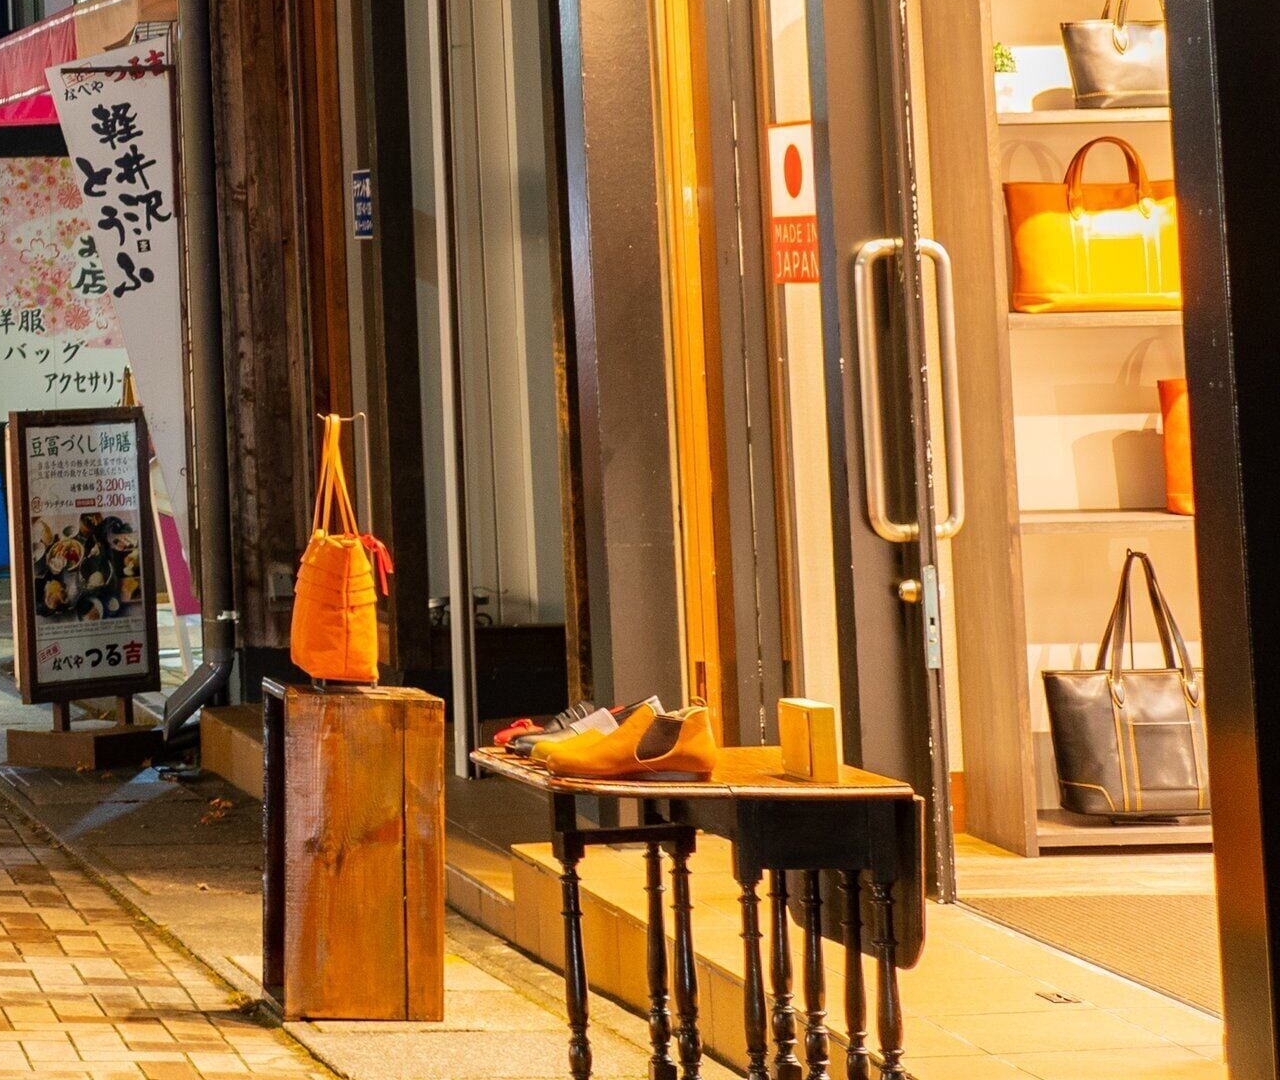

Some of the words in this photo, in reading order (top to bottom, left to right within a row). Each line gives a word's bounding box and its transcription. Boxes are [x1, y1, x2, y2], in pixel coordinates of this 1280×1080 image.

[63, 79, 104, 102] なべや
[91, 102, 172, 231] 軽井沢
[75, 156, 155, 299] とうふ
[774, 222, 803, 244] MADE
[806, 222, 818, 244] IN
[776, 249, 820, 279] JAPAN
[4, 339, 86, 364] バッグ
[52, 655, 84, 671] なべや
[84, 640, 144, 668] つる吉
